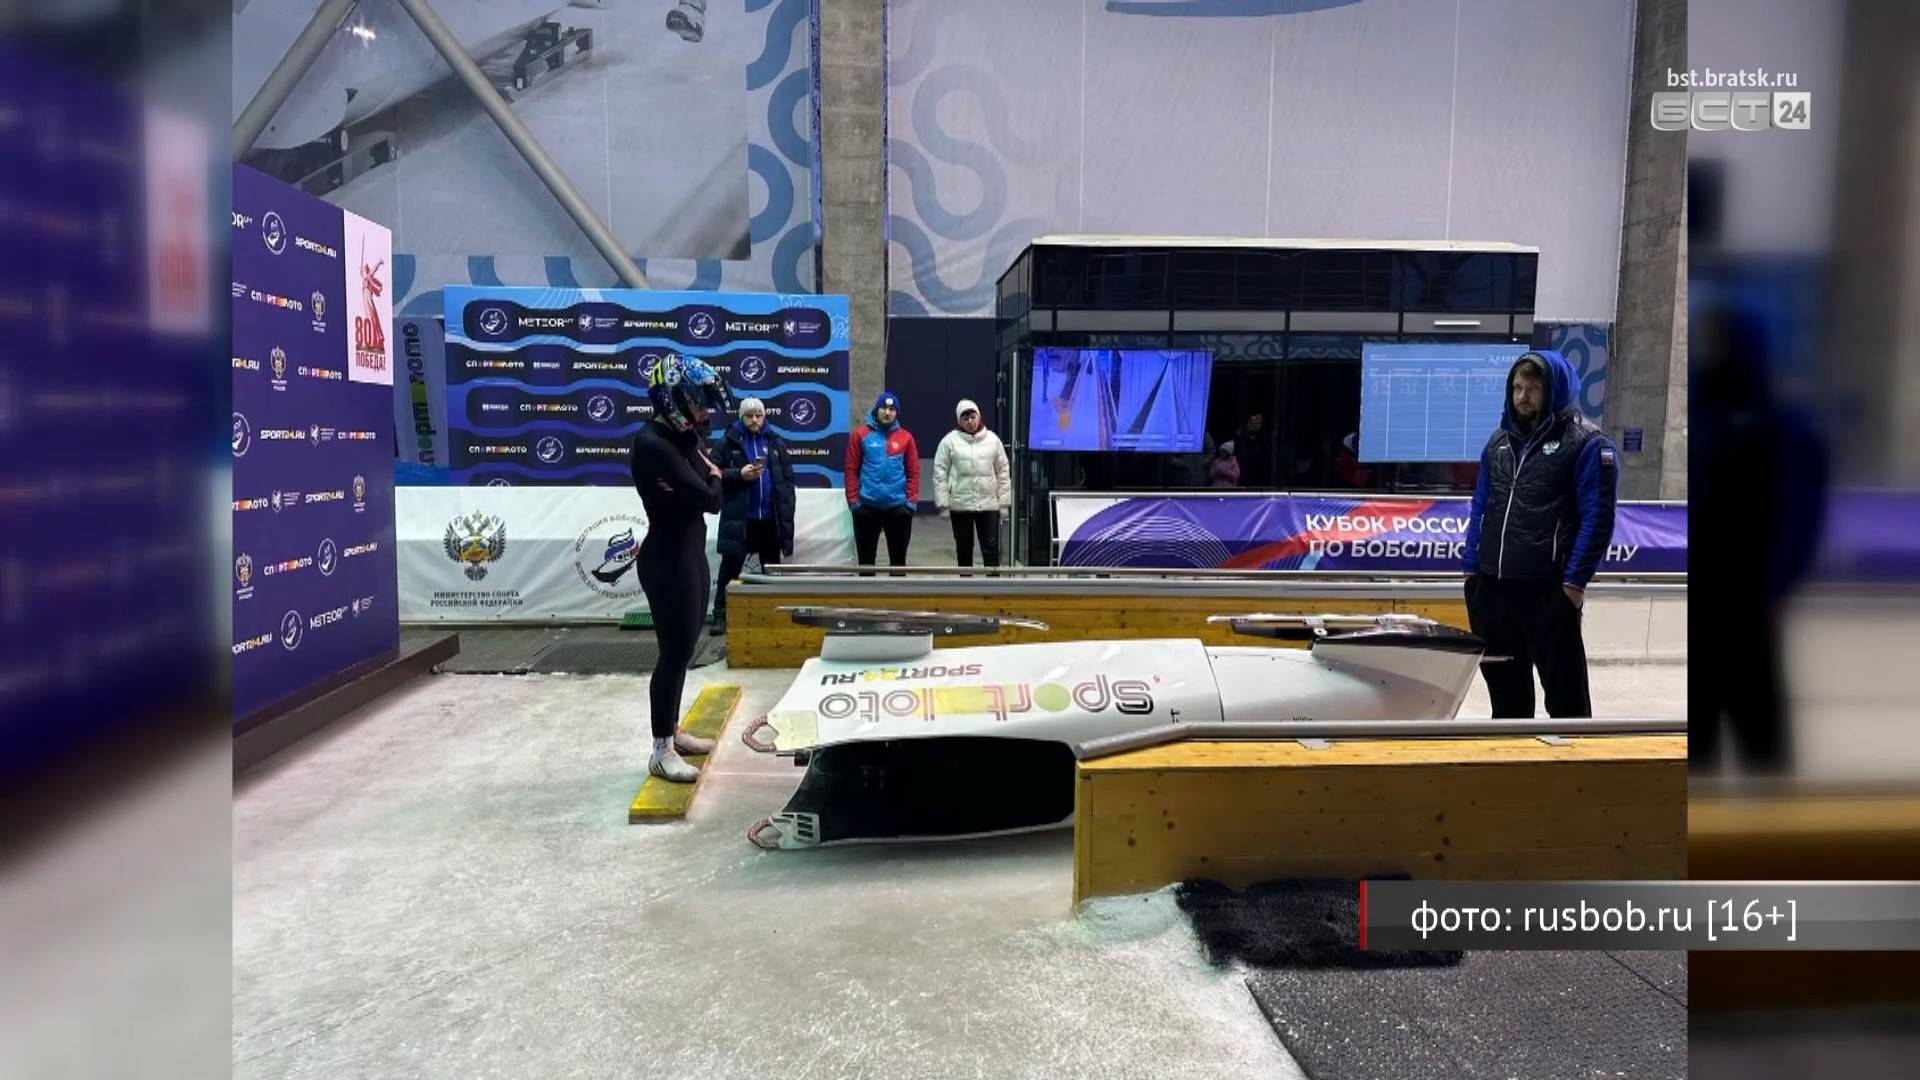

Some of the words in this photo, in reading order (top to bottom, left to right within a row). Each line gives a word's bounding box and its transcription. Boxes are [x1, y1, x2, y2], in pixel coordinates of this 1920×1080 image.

[355, 316, 372, 347] 80
[355, 351, 386, 371] ПОБЕДА!
[1305, 514, 1389, 533] КУБОК
[1308, 539, 1344, 558] ПО
[433, 590, 490, 600] МИНИСТЕРСТВО
[820, 664, 984, 686] SPORT24.RU
